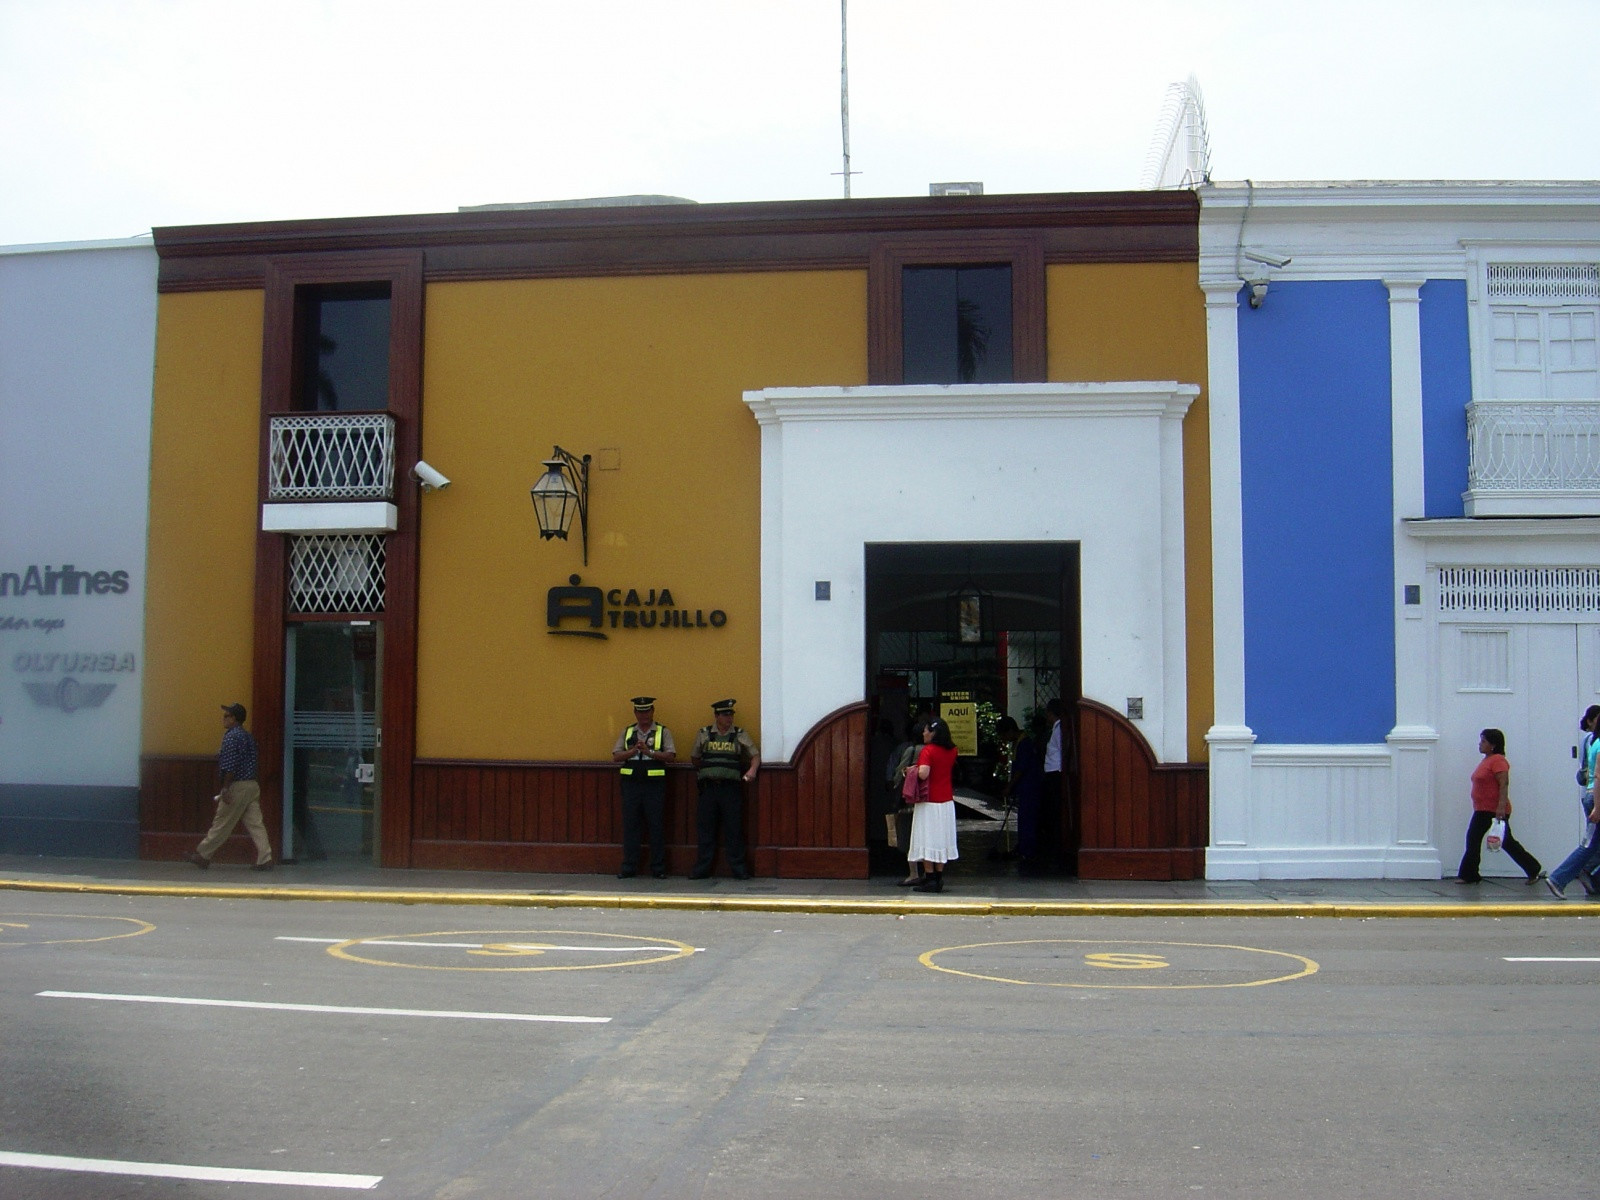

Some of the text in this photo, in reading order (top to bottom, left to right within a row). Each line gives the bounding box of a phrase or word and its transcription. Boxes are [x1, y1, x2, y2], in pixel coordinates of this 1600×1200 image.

[606, 588, 674, 607] CAJA
[606, 609, 728, 628] TRUJILLO
[14, 652, 135, 673] OLTURSA
